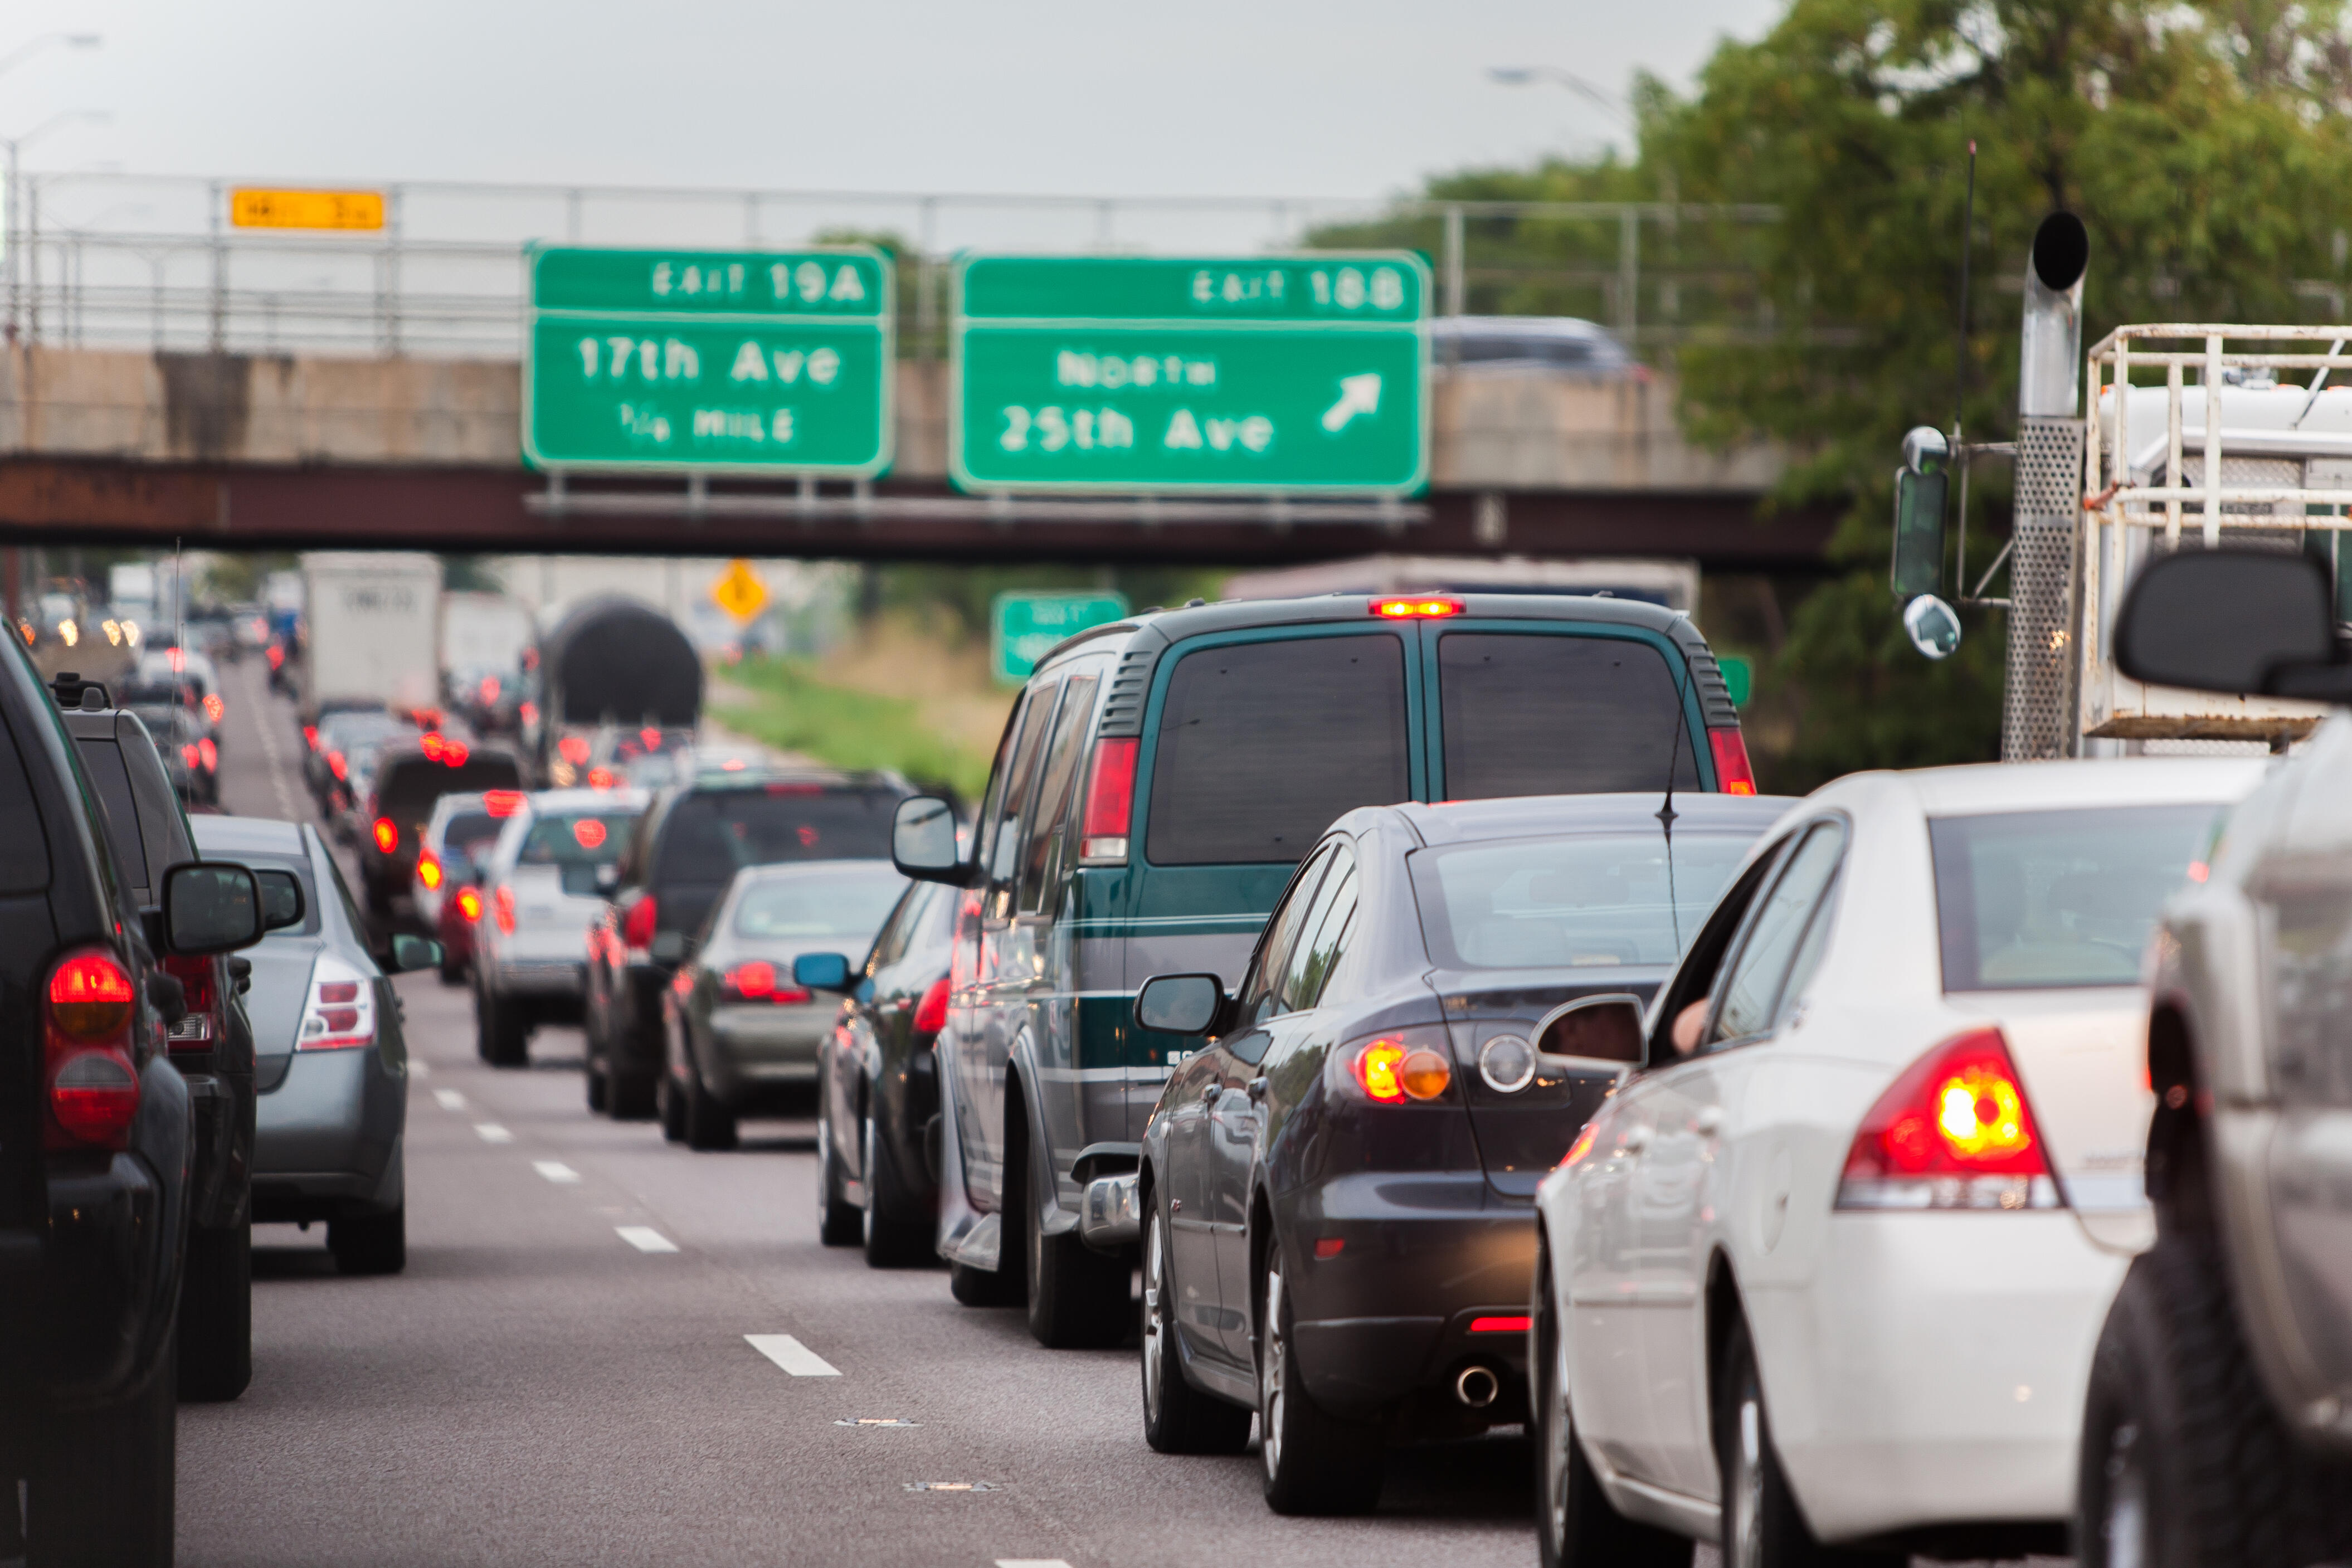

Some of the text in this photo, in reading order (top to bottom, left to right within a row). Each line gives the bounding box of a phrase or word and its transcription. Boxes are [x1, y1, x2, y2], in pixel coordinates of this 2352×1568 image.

[770, 260, 865, 303] 19A
[578, 336, 840, 384] 17th Ave
[693, 408, 793, 443] MILE
[999, 405, 1274, 452] 25th Ave
